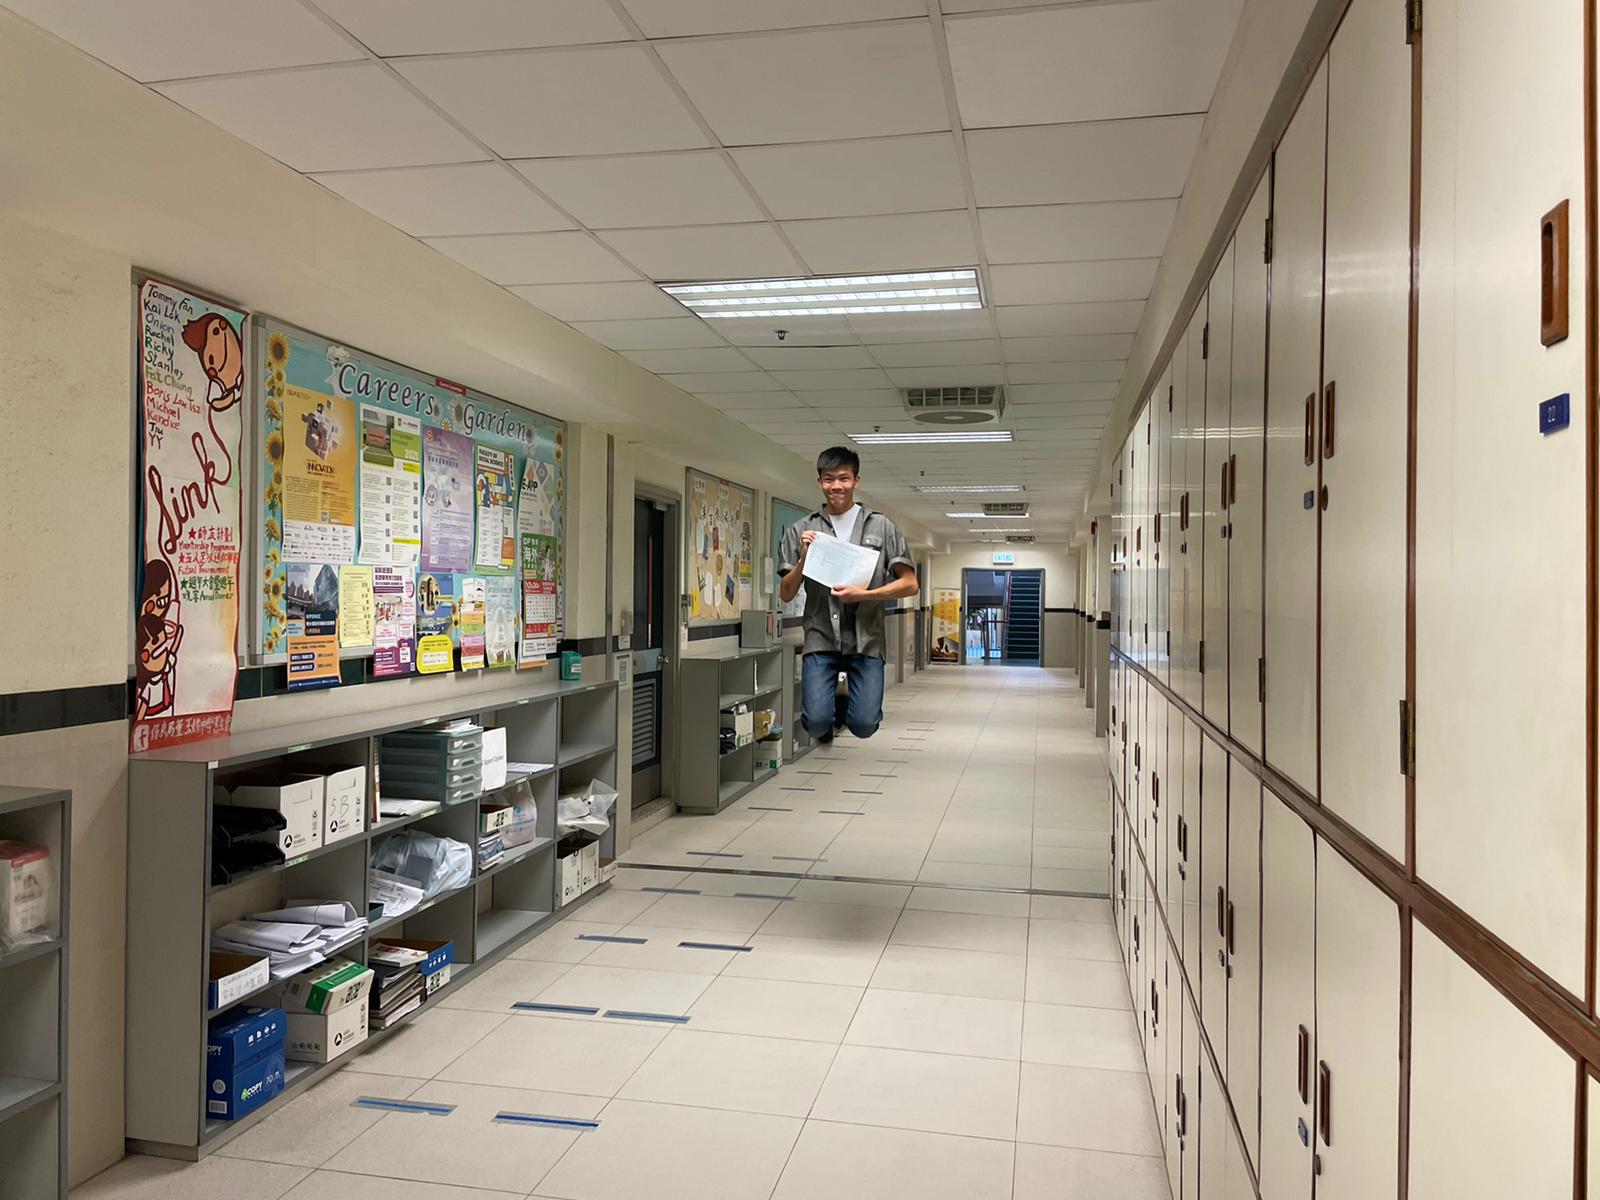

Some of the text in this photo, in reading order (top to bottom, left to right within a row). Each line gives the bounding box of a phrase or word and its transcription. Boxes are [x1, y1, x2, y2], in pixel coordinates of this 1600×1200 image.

[144, 299, 161, 315] Kai
[148, 284, 193, 315] Tommy Fan
[145, 313, 174, 334] Onion
[145, 325, 175, 346] Rachel
[145, 336, 174, 360] Ricky
[145, 351, 184, 380] Stanley
[146, 381, 171, 403] Boris
[164, 374, 194, 402] Chung
[146, 396, 180, 420] Michael
[339, 363, 529, 441] Careers Garden
[147, 409, 181, 431] Kandice
[148, 432, 164, 450] YY
